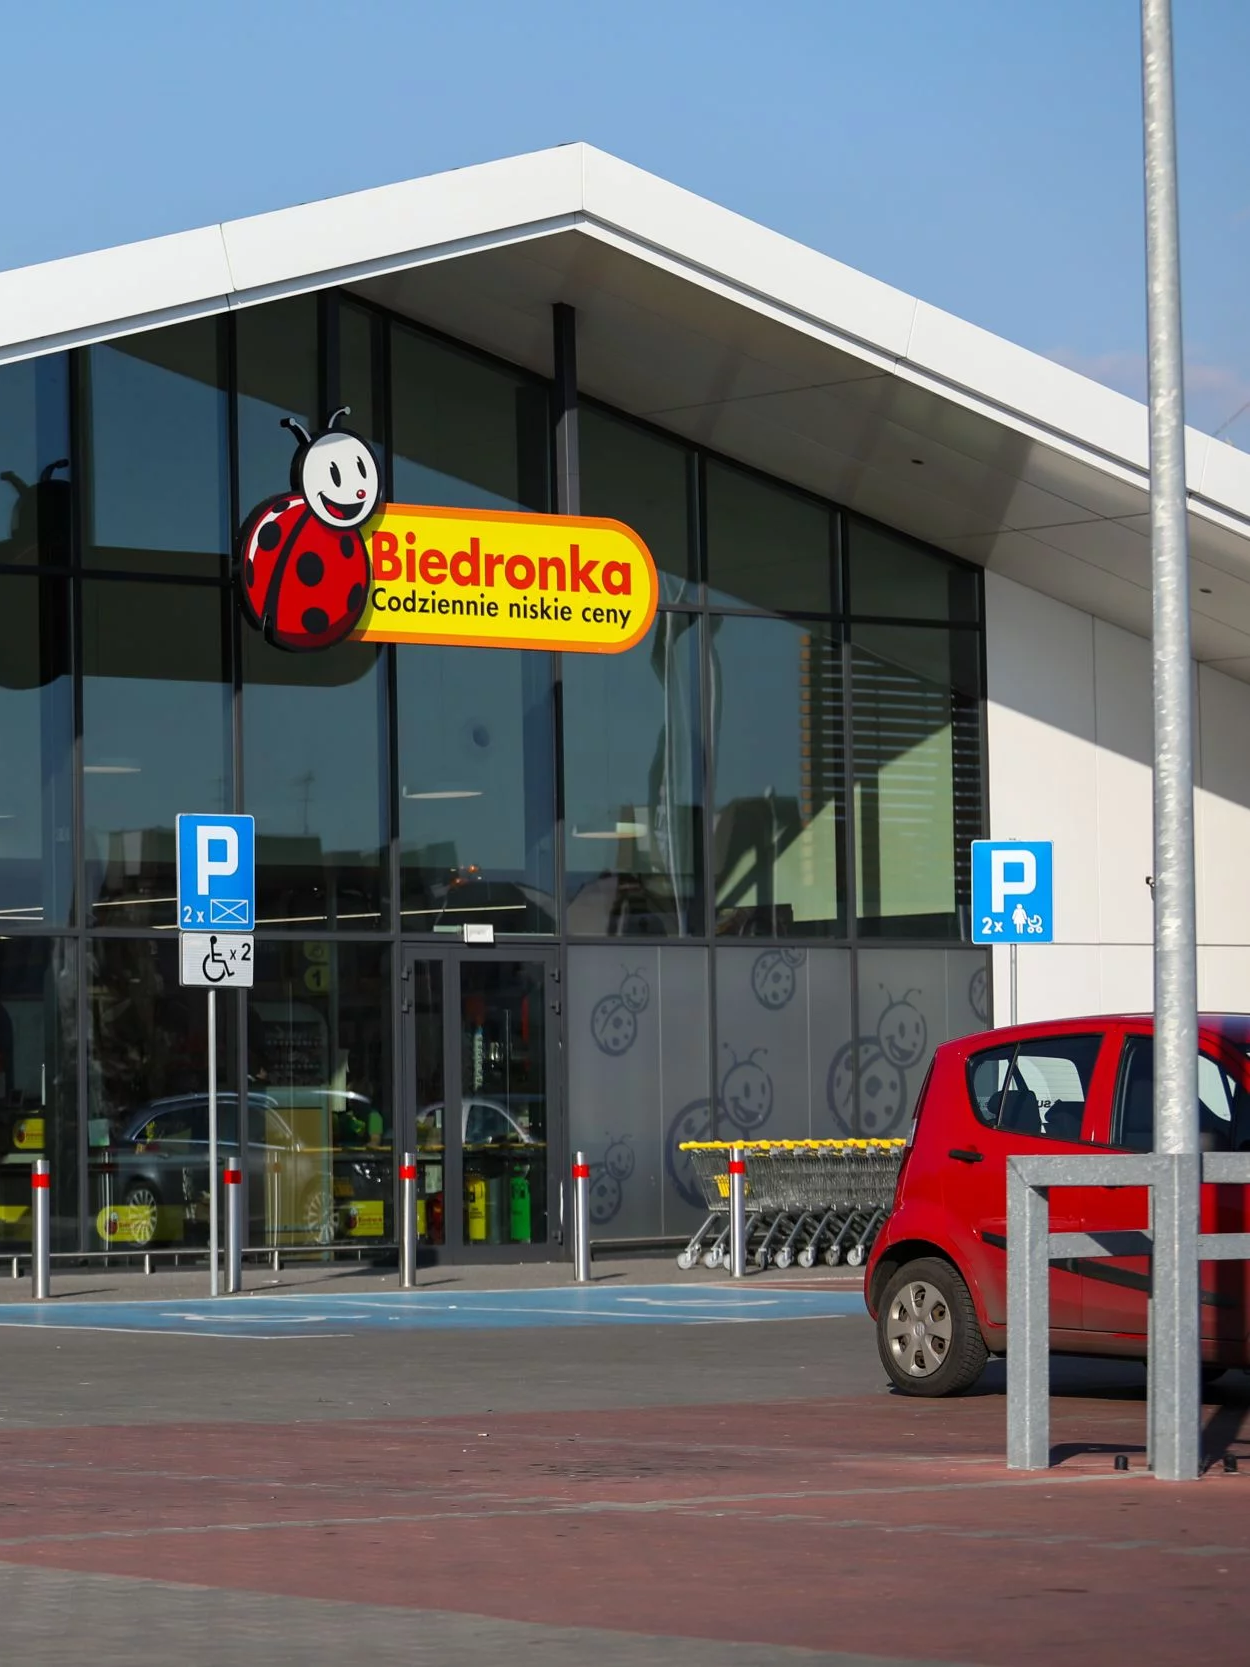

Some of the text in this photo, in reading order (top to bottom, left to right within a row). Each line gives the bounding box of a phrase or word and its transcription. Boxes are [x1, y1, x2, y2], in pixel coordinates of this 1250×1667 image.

[371, 531, 632, 596] Biedronka
[371, 588, 632, 629] Codziennie niskie ceny
[196, 825, 239, 896] P
[991, 849, 1037, 913] P
[183, 905, 192, 923] 2
[241, 942, 251, 961] 2
[311, 970, 321, 987] 1
